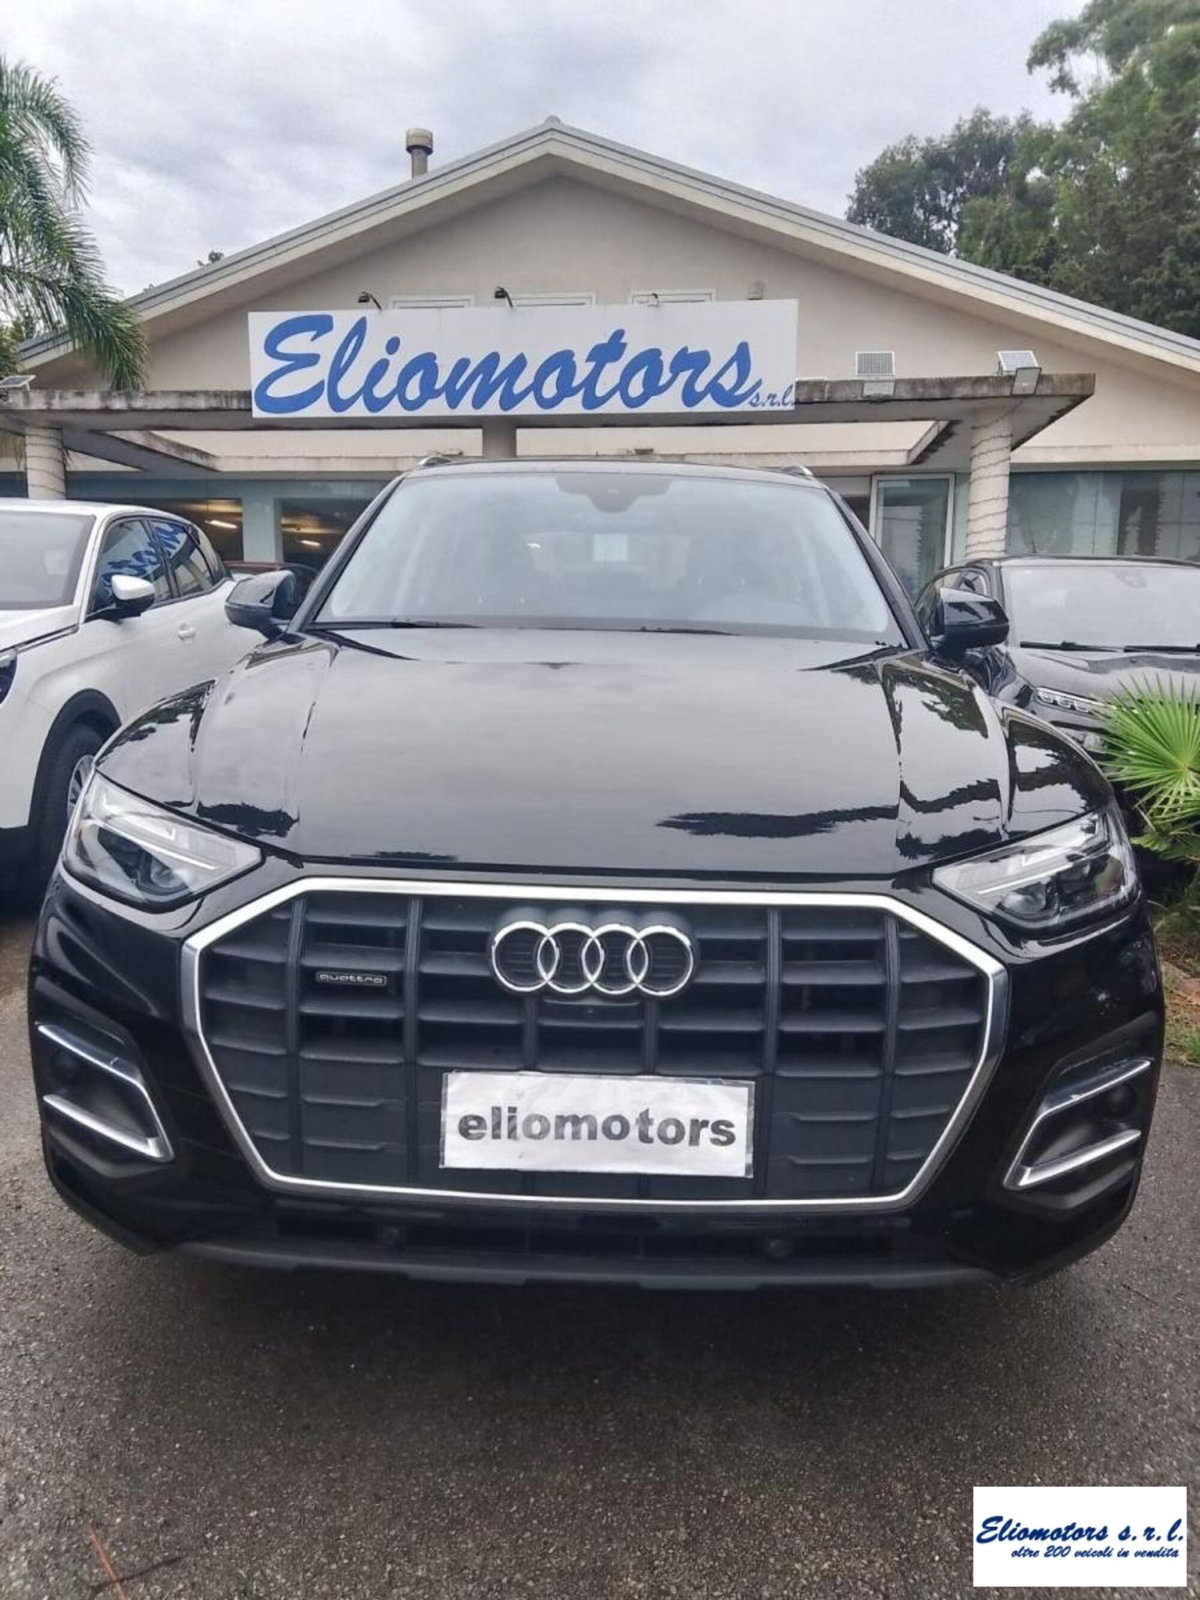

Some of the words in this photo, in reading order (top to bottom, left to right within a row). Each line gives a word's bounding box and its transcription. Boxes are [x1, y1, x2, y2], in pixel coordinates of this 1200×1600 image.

[253, 314, 763, 413] Eliomotors
[319, 974, 383, 984] quattro
[458, 1106, 736, 1147] eliomotors
